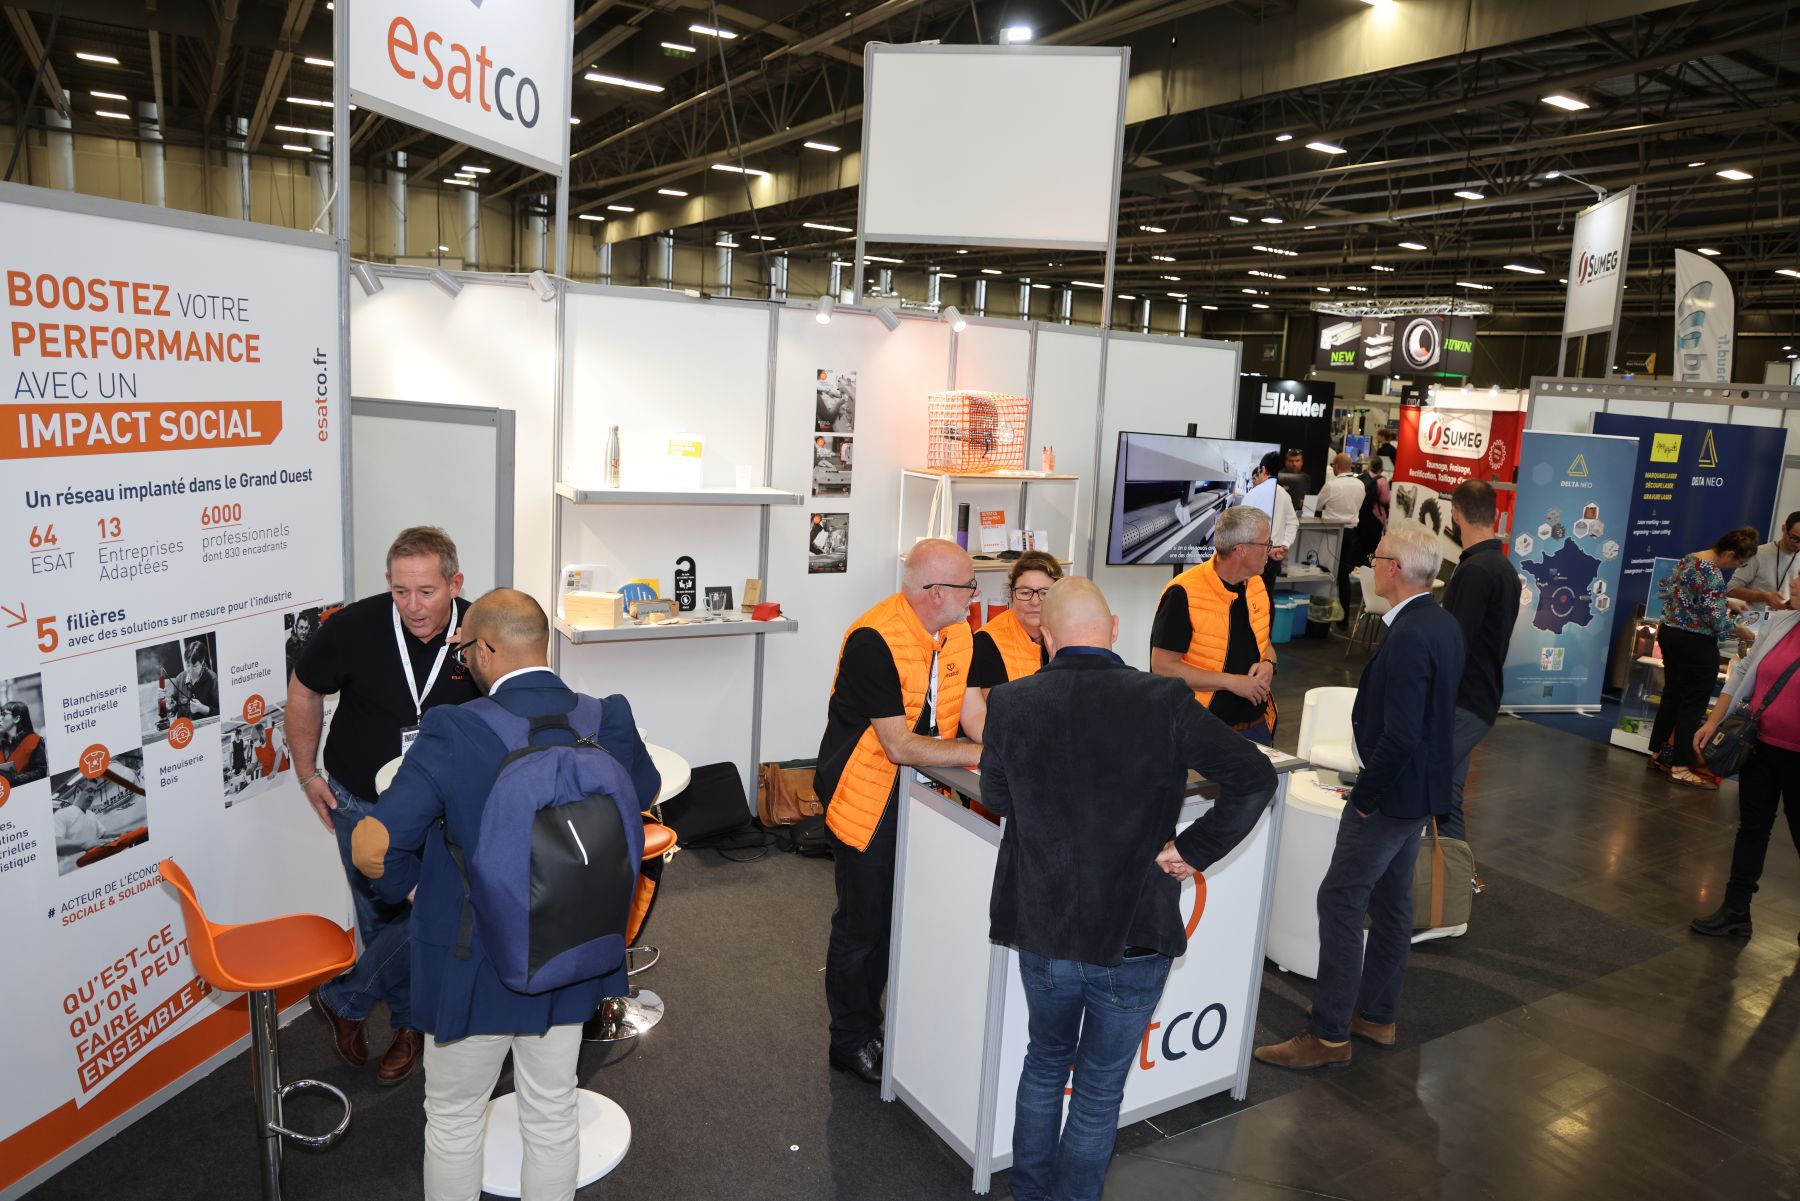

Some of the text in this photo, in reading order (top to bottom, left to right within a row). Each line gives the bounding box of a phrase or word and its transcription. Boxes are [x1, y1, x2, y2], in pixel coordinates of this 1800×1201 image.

[387, 16, 540, 129] esatco
[7, 270, 250, 322] BOOSTEZ VOTRE
[11, 321, 261, 363] PERFORMANCE
[1331, 351, 1355, 362] NEW
[14, 371, 137, 399] AVEC UN
[313, 347, 328, 442] esatco.fr
[1279, 393, 1326, 418] binder
[18, 409, 262, 449] IMPACT SOCIAL
[25, 468, 313, 508] Un réseau implanté dans le Grand Ouest
[1705, 477, 1723, 487] NEO
[201, 503, 242, 526] 6000
[29, 524, 58, 548] 64
[97, 517, 122, 538] 13
[202, 523, 290, 551] professionnels
[31, 551, 76, 574] ESAT
[98, 539, 184, 564] Entreprises
[202, 540, 288, 563] dont 830 encadrants
[99, 558, 169, 582] Adaptées
[36, 608, 126, 654] 5 filières
[67, 590, 292, 648] avec des solutions sur mesure pour l'industrie
[230, 660, 259, 675] Couture
[231, 667, 271, 686] industrielle
[62, 684, 128, 709] Blanchisserie
[63, 699, 119, 721] industrielle
[65, 717, 97, 735] Textile
[159, 753, 204, 776] Menuiserie
[160, 774, 179, 788] Bois
[61, 888, 102, 913] ACTEUR
[104, 881, 117, 894] DE
[62, 900, 106, 926] SOCIALE
[108, 895, 116, 906] &
[62, 923, 175, 1015] QU'EST-CE
[69, 938, 189, 1037] QU'ON PEUT
[76, 1003, 140, 1063] FAIRE
[82, 977, 206, 1087] ENSEMBLE ?
